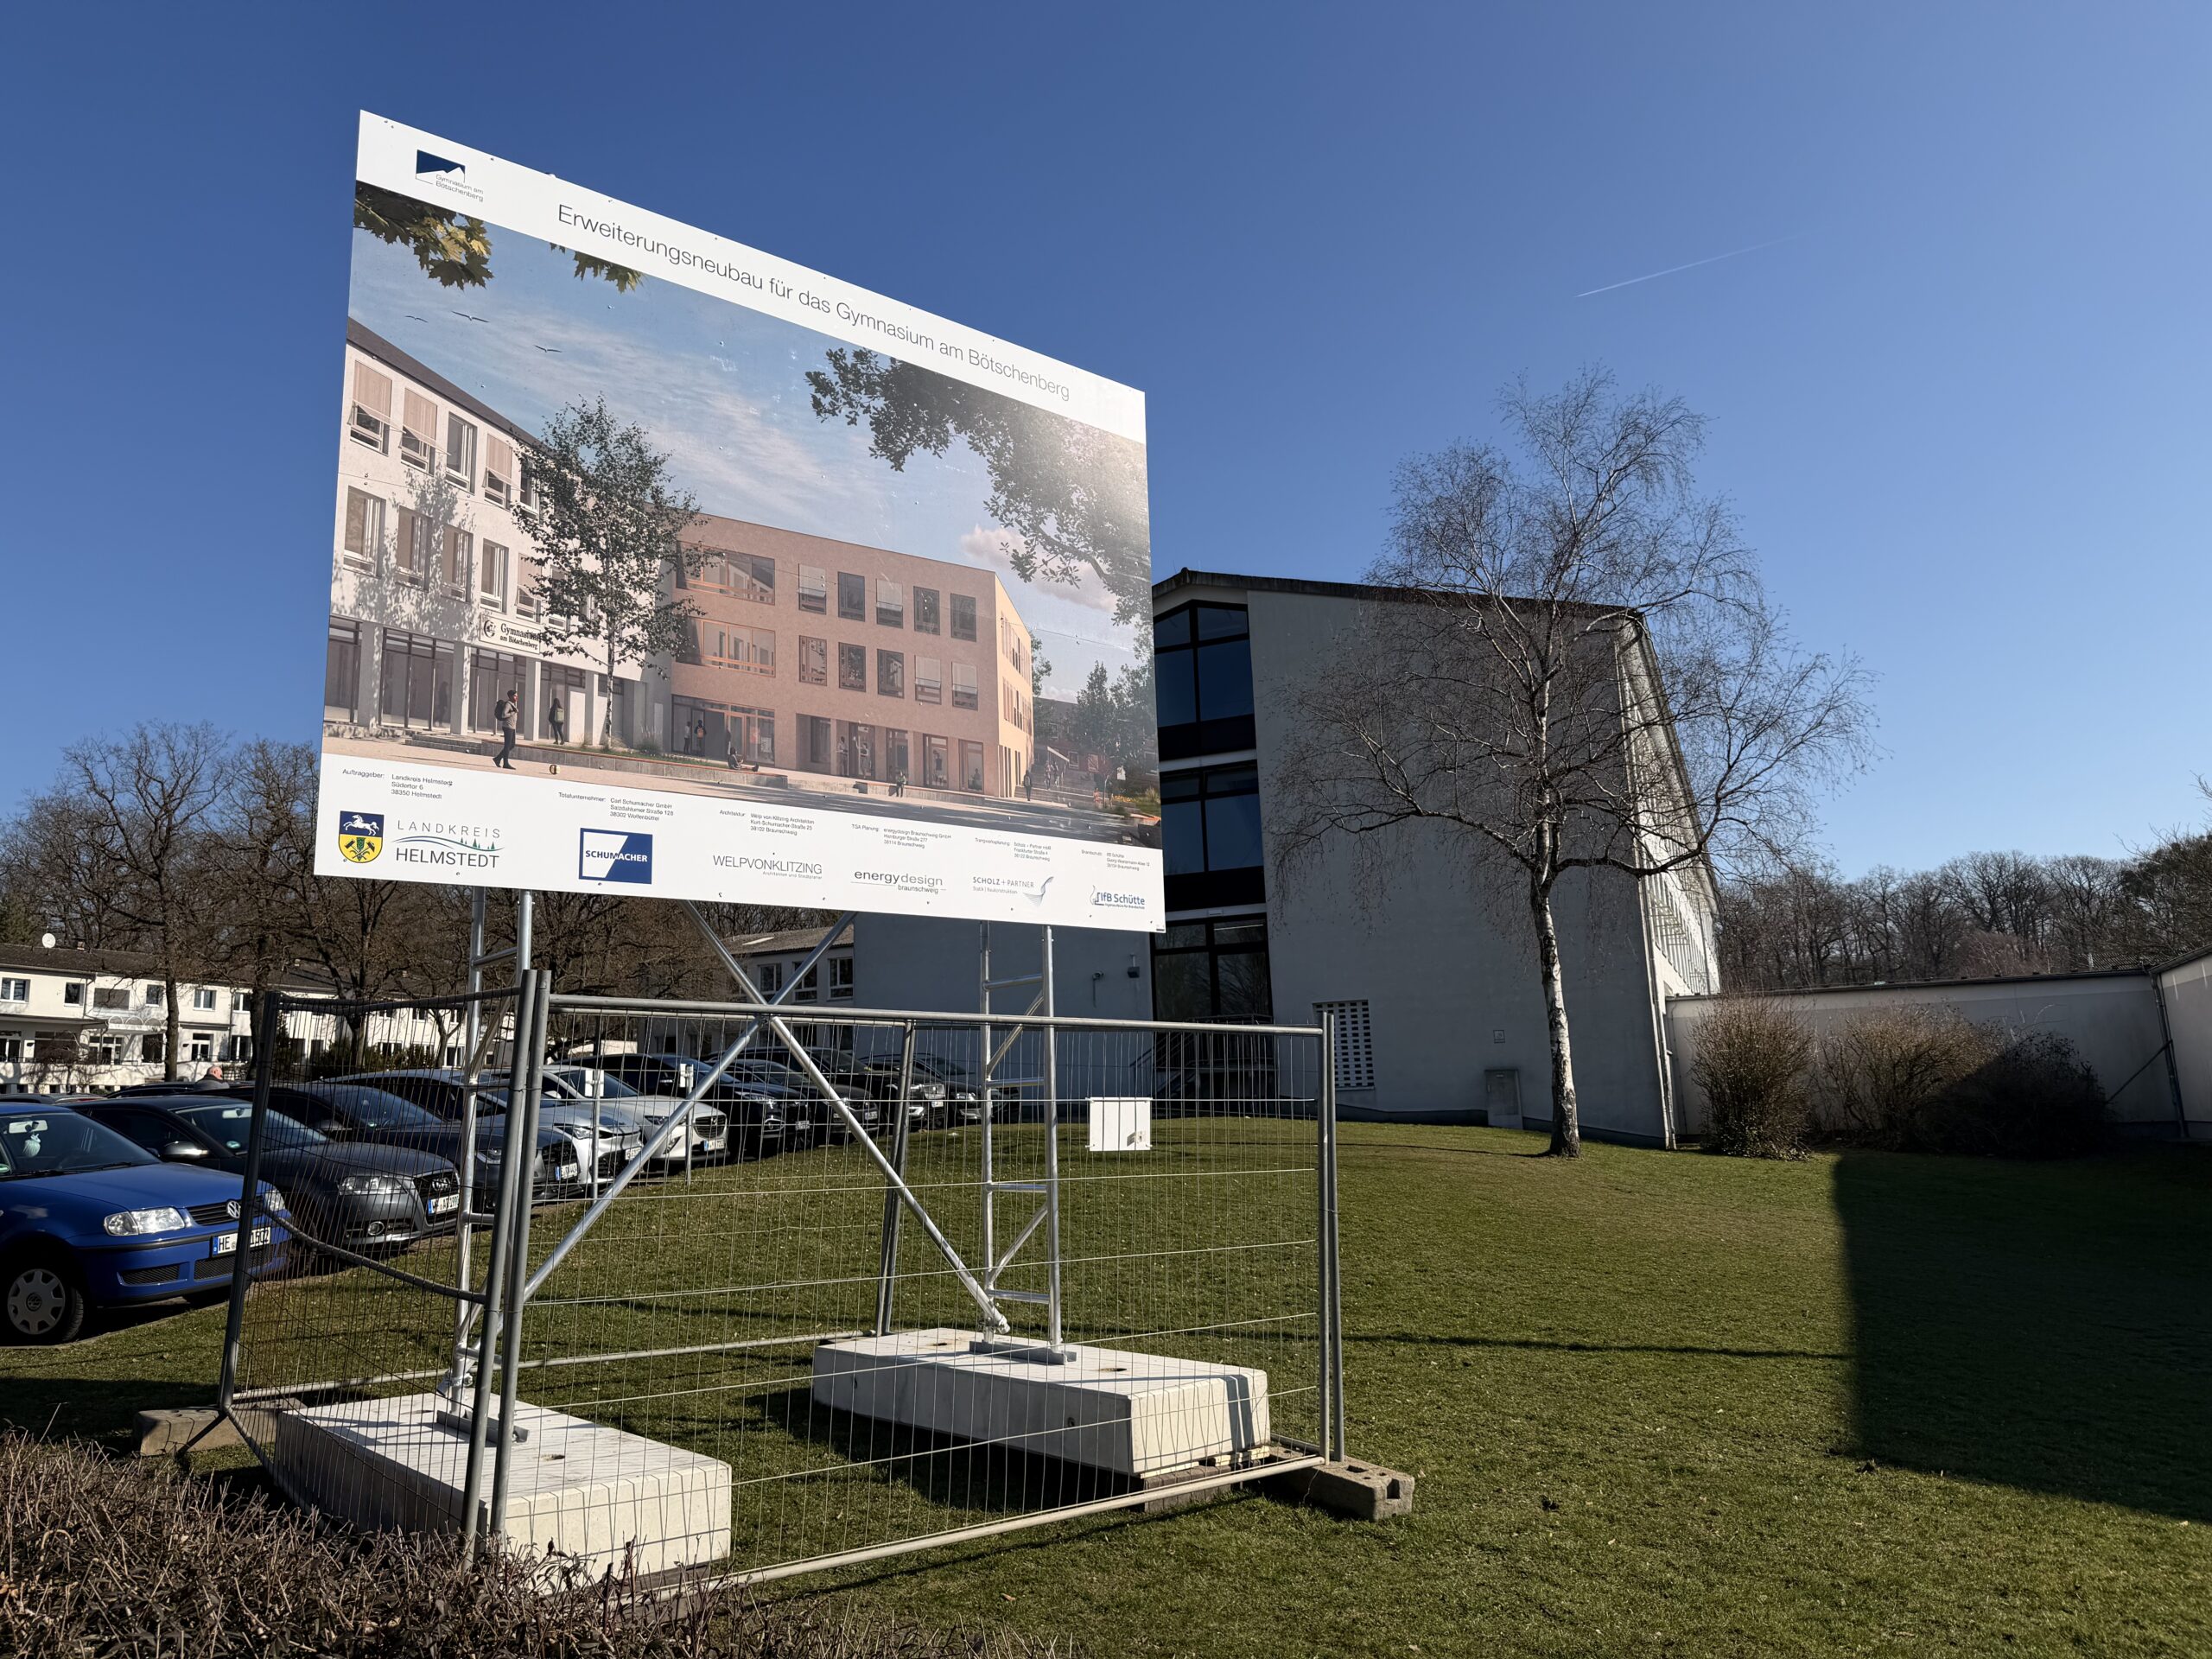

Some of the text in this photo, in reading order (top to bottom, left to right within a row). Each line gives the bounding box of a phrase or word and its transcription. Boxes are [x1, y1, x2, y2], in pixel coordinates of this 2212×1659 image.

[435, 174, 473, 191] Gymnasium
[558, 204, 1070, 402] Erweiterungsneubau für das Gymnasium am Bötschenberg
[342, 768, 453, 786] Auftraggeber: Landkreis Helmstedt
[391, 781, 418, 790] Südertor
[391, 788, 442, 799] 38350 Helmstedt
[558, 791, 607, 803] Totalunternehmer:
[622, 798, 655, 808] Schumacher
[627, 812, 660, 822] Wolfenbüttel
[397, 819, 501, 839] LANDKREIS
[396, 848, 499, 868] HELMSTEDT
[585, 850, 648, 862] SCHUMACHER
[713, 855, 823, 874] WELPVONKLITZING
[854, 871, 943, 887] energydesign
[973, 876, 1001, 886] SCHOLZ
[1007, 880, 1034, 888] PARTNER
[898, 884, 939, 894] braunschweig
[1101, 892, 1146, 906] IfB Schütte
[219, 1236, 231, 1251] HE
